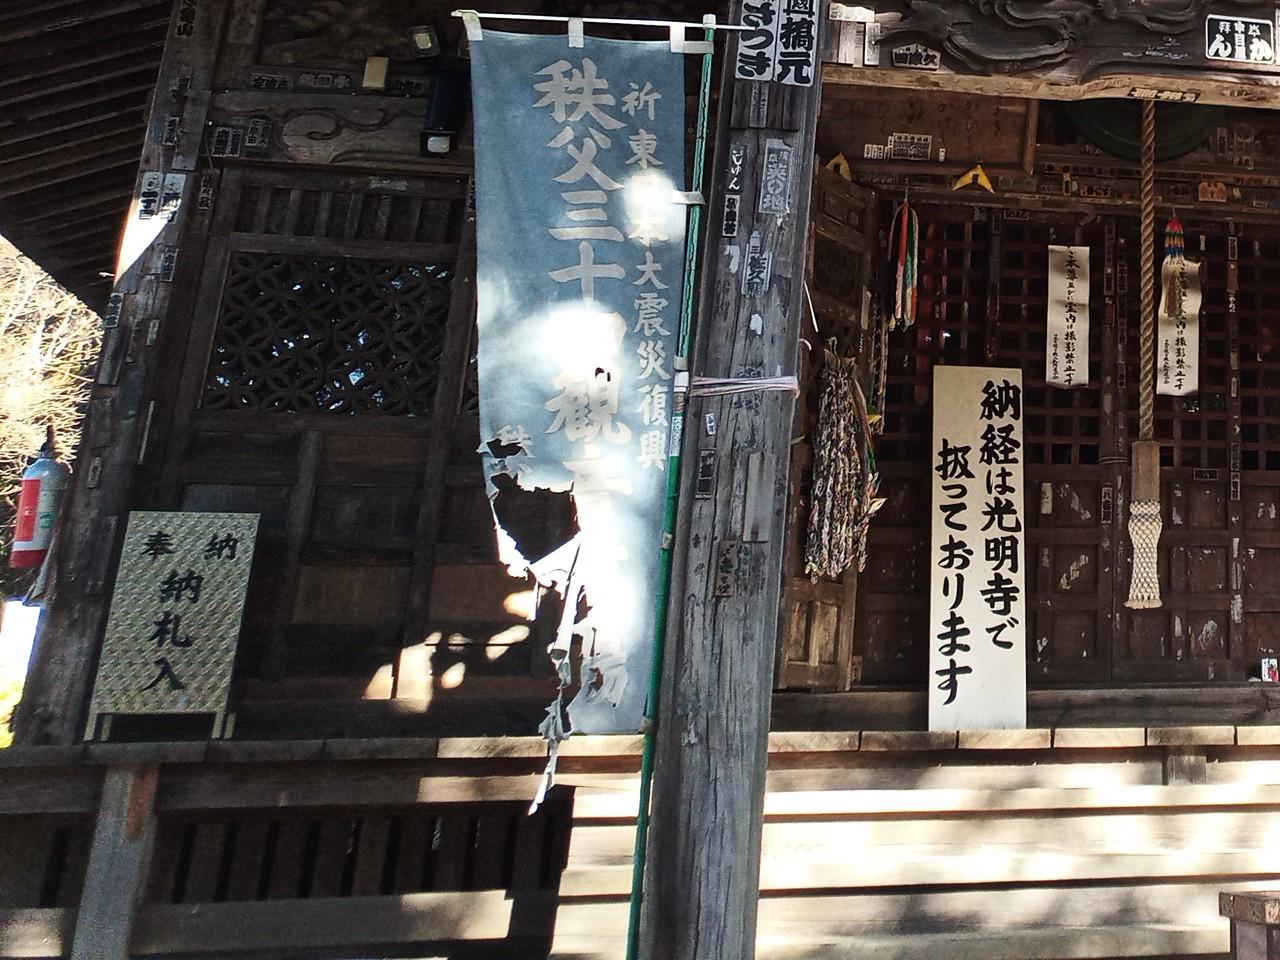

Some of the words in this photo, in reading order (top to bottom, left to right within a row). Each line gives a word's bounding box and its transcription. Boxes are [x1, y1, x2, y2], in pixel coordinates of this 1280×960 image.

[738, 2, 775, 77] さつき
[935, 438, 976, 705] 扱っております
[980, 380, 1021, 649] 納経は光明寺で
